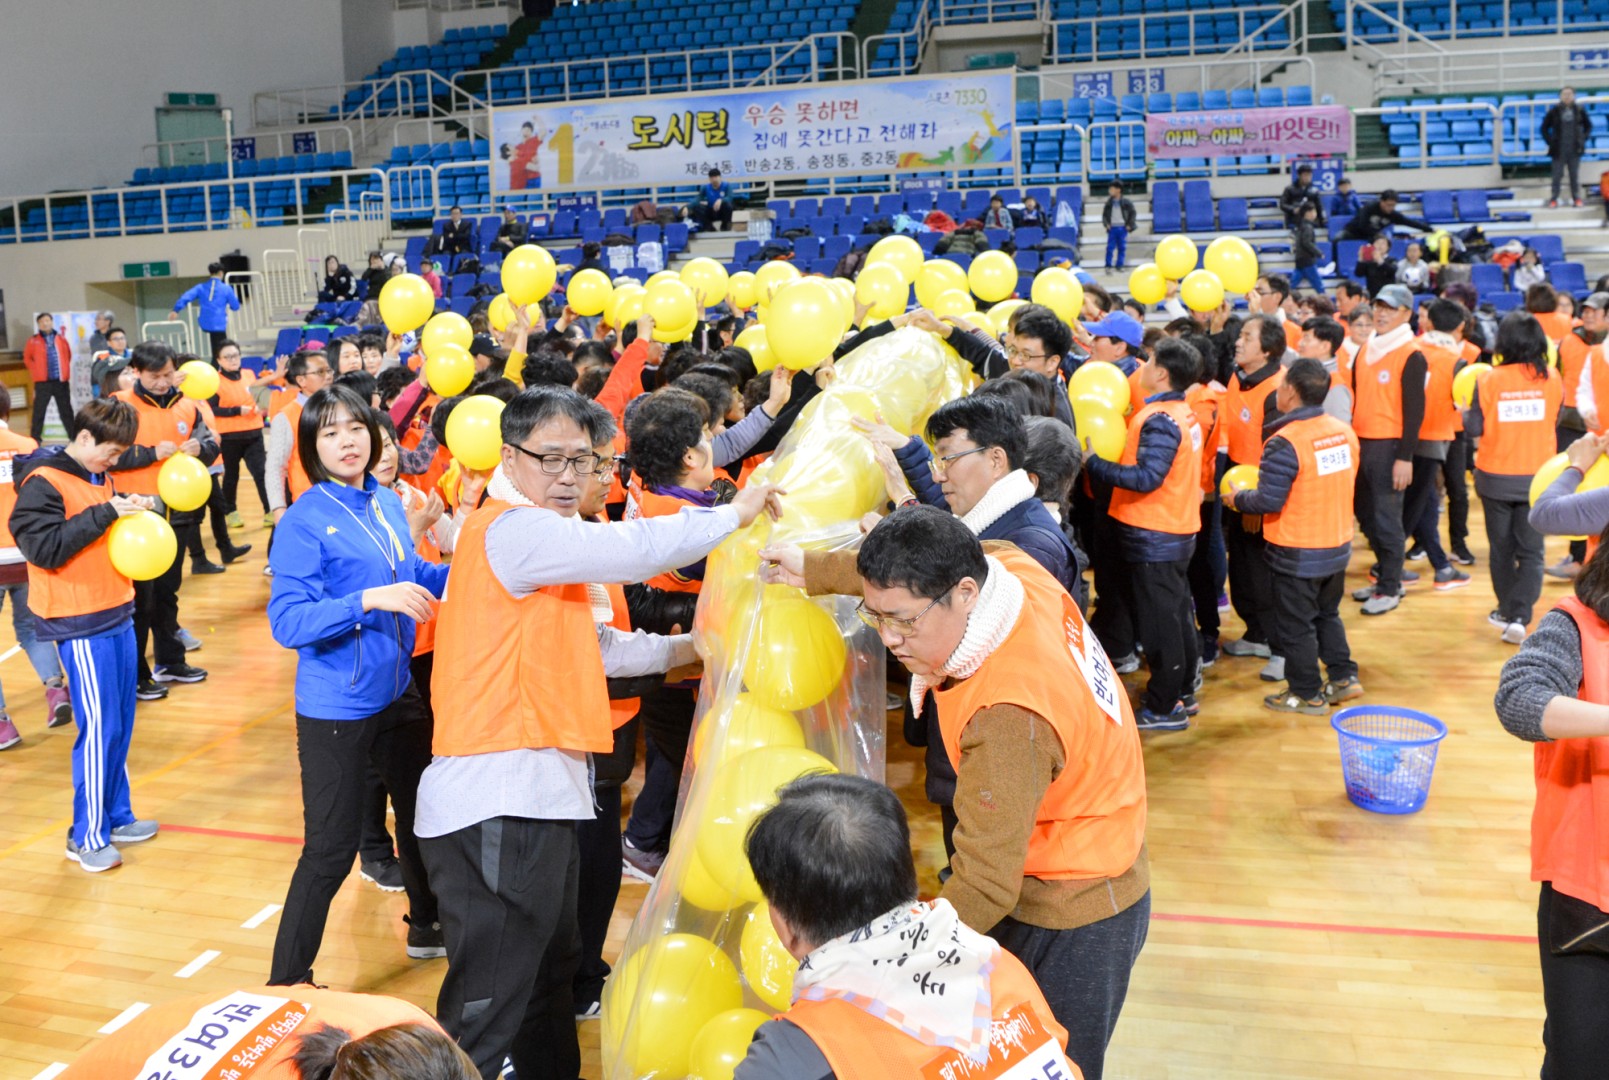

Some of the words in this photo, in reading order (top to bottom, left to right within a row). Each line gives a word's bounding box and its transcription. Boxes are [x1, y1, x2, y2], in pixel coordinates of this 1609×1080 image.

[954, 87, 988, 107] 7330
[745, 104, 787, 127] 우승
[796, 99, 860, 124] 못하면
[627, 107, 731, 150] 도시팀
[752, 131, 788, 151] 집에
[798, 126, 873, 149] 못간다고
[879, 121, 939, 143] 전해라
[1261, 115, 1341, 142] 파잇팅!!
[744, 156, 801, 173] 반송2동,
[806, 152, 856, 170] 송정동,
[860, 149, 898, 167] 중2동
